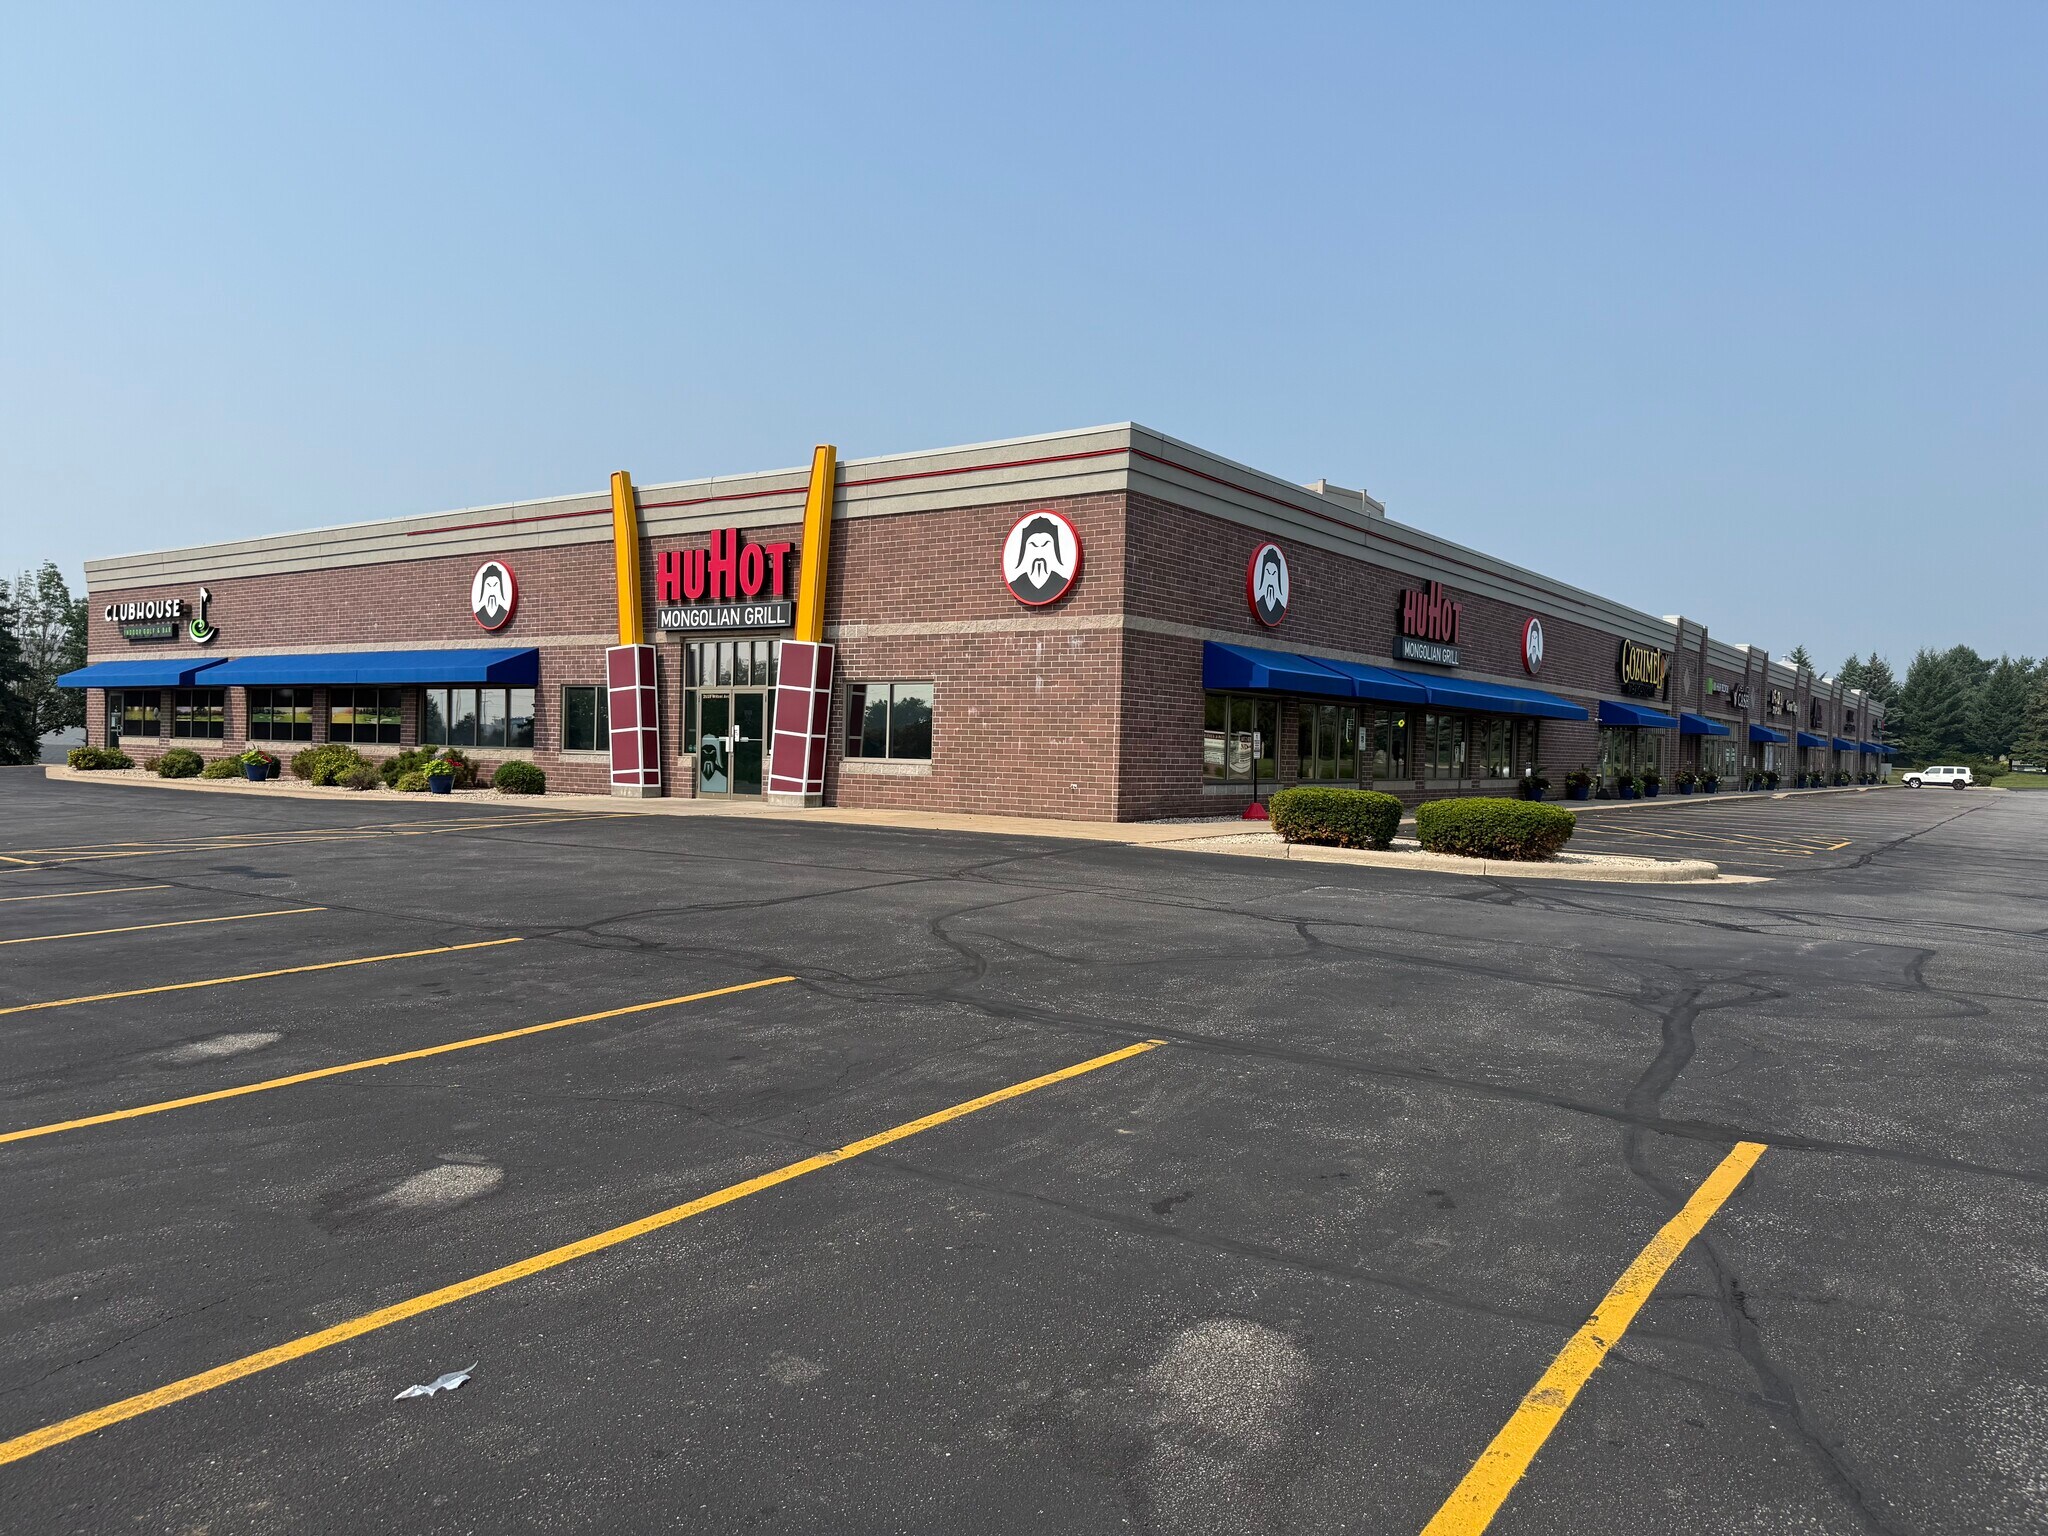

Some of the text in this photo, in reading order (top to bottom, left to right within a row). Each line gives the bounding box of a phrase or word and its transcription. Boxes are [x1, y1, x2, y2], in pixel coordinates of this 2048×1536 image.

[105, 599, 181, 621] CLUBHOUSE
[661, 606, 786, 628] MONGOLIAN GRILL
[1405, 641, 1459, 665] MONGOLIAN GRILL
[1623, 639, 1662, 688] COZUMEL
